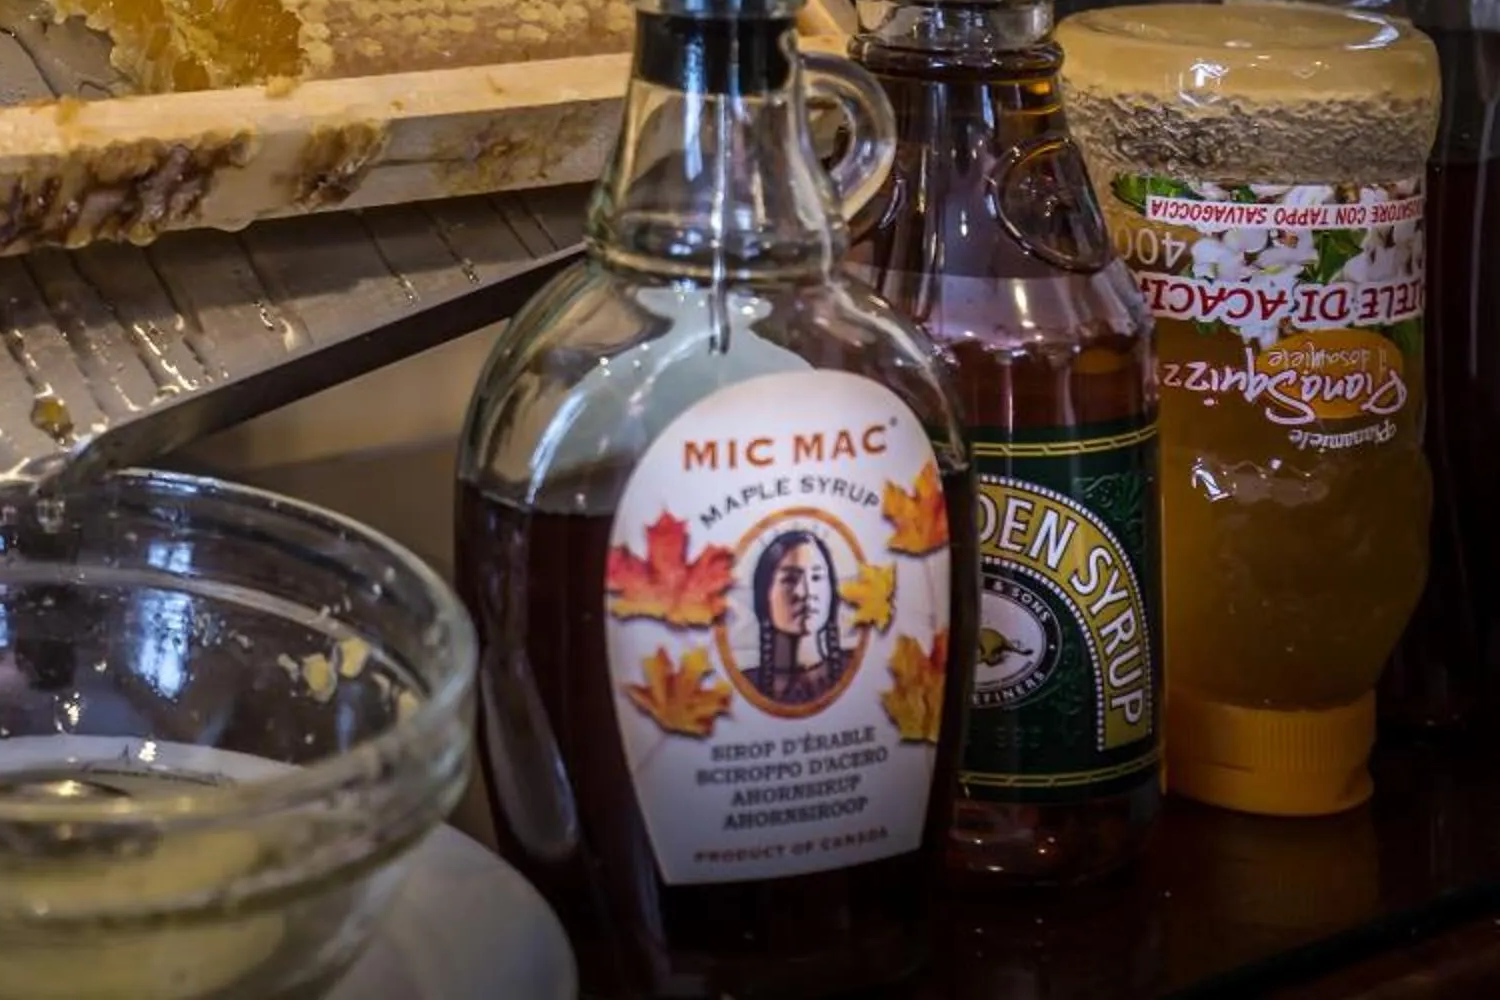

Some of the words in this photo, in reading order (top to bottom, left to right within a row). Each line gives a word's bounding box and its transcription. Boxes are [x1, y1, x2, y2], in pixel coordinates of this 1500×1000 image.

[1150, 199, 1268, 225] SALVAGOCCIA
[1275, 207, 1329, 226] TAPPO
[1334, 208, 1368, 225] CON
[1140, 276, 1287, 322] ACACI
[1296, 288, 1349, 324] DI
[1358, 280, 1424, 320] IELE
[682, 437, 775, 471] MIC
[792, 424, 888, 464] MAC
[699, 477, 791, 530] MAPLE
[799, 475, 880, 508] SYRUP
[1011, 587, 1051, 623] SONS
[1069, 546, 1145, 725] SYRUP
[711, 744, 775, 762] SIROP
[782, 726, 876, 755] D'ÉRABLE
[696, 762, 803, 786] SCIROPPO
[808, 746, 888, 776] D'ACERO
[730, 773, 862, 808] AHORNSIRUP
[721, 797, 869, 831] AHORNSIROOP
[693, 845, 784, 863] PRODUCT
[791, 841, 813, 854] OF
[819, 826, 888, 851] CANADA
